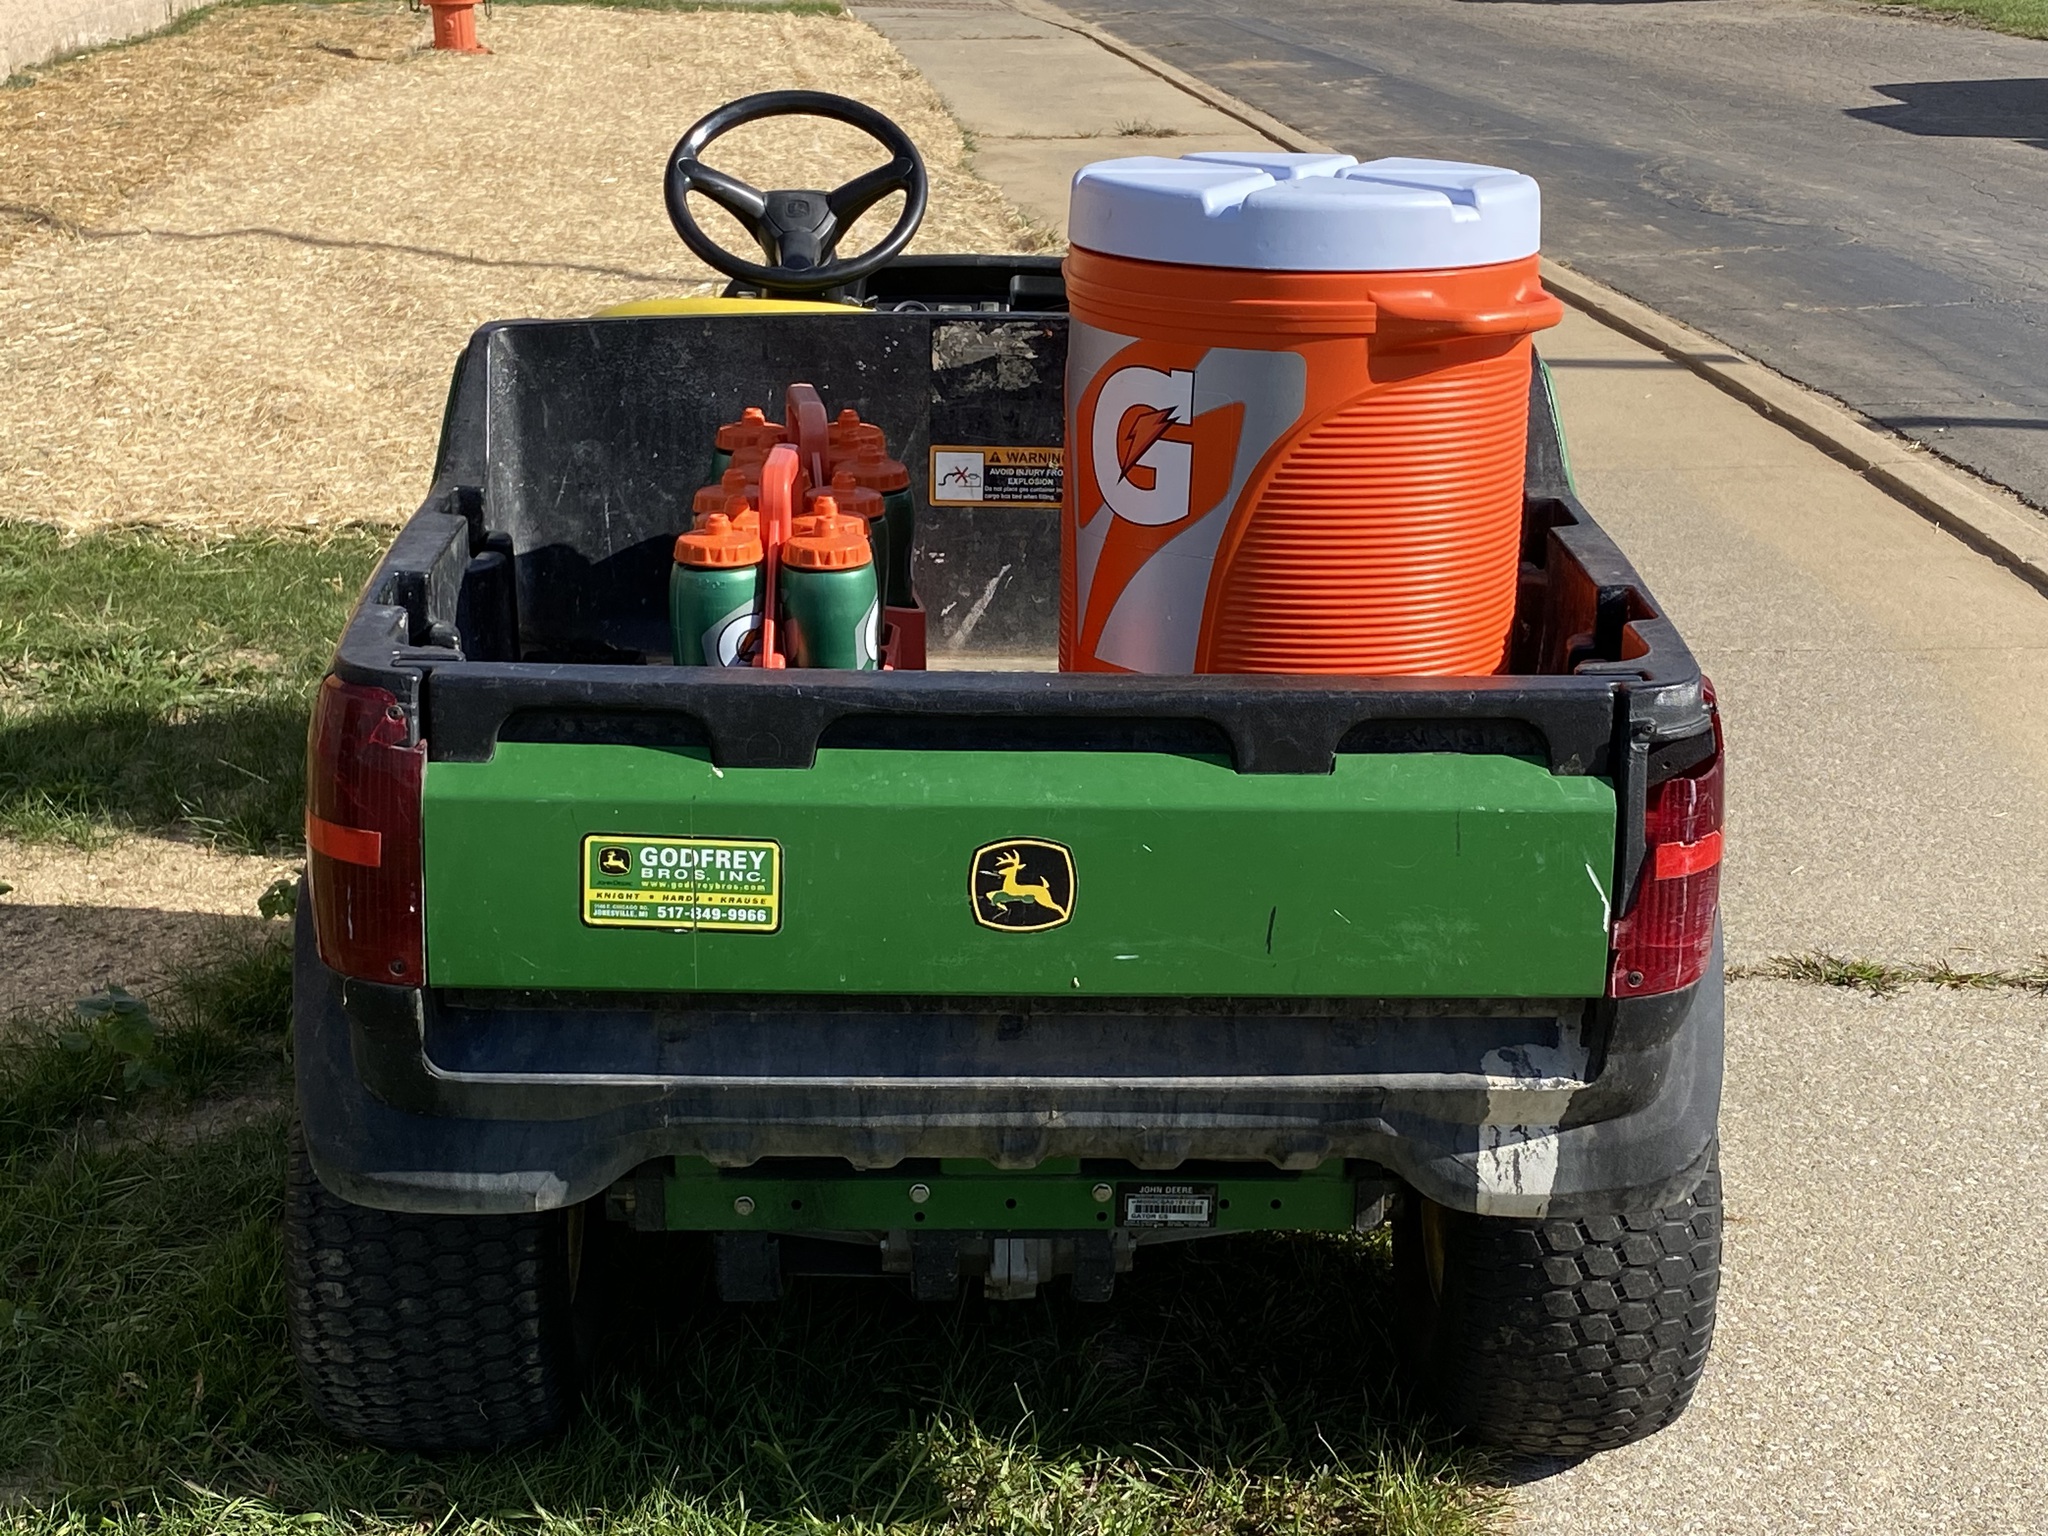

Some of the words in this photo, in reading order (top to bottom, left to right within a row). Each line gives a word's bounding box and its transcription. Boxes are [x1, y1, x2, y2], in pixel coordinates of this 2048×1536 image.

[1092, 364, 1195, 527] G
[1007, 451, 1065, 463] WARNIN
[989, 468, 1014, 476] AVOID
[1016, 468, 1044, 476] INJURY
[1046, 468, 1064, 477] FRO
[1008, 477, 1054, 486] EXPLOSION
[639, 846, 766, 870] GODFREY
[641, 868, 711, 882] BROS.
[719, 871, 767, 883] INC.
[641, 880, 766, 891] www.godfreybros.com
[596, 892, 640, 900] KNIGHT
[720, 896, 767, 905] KRAUSE
[638, 910, 649, 918] MI
[657, 906, 767, 922] 517-849-9966
[1139, 1185, 1163, 1194] JOHN
[1165, 1186, 1193, 1194] DEERE
